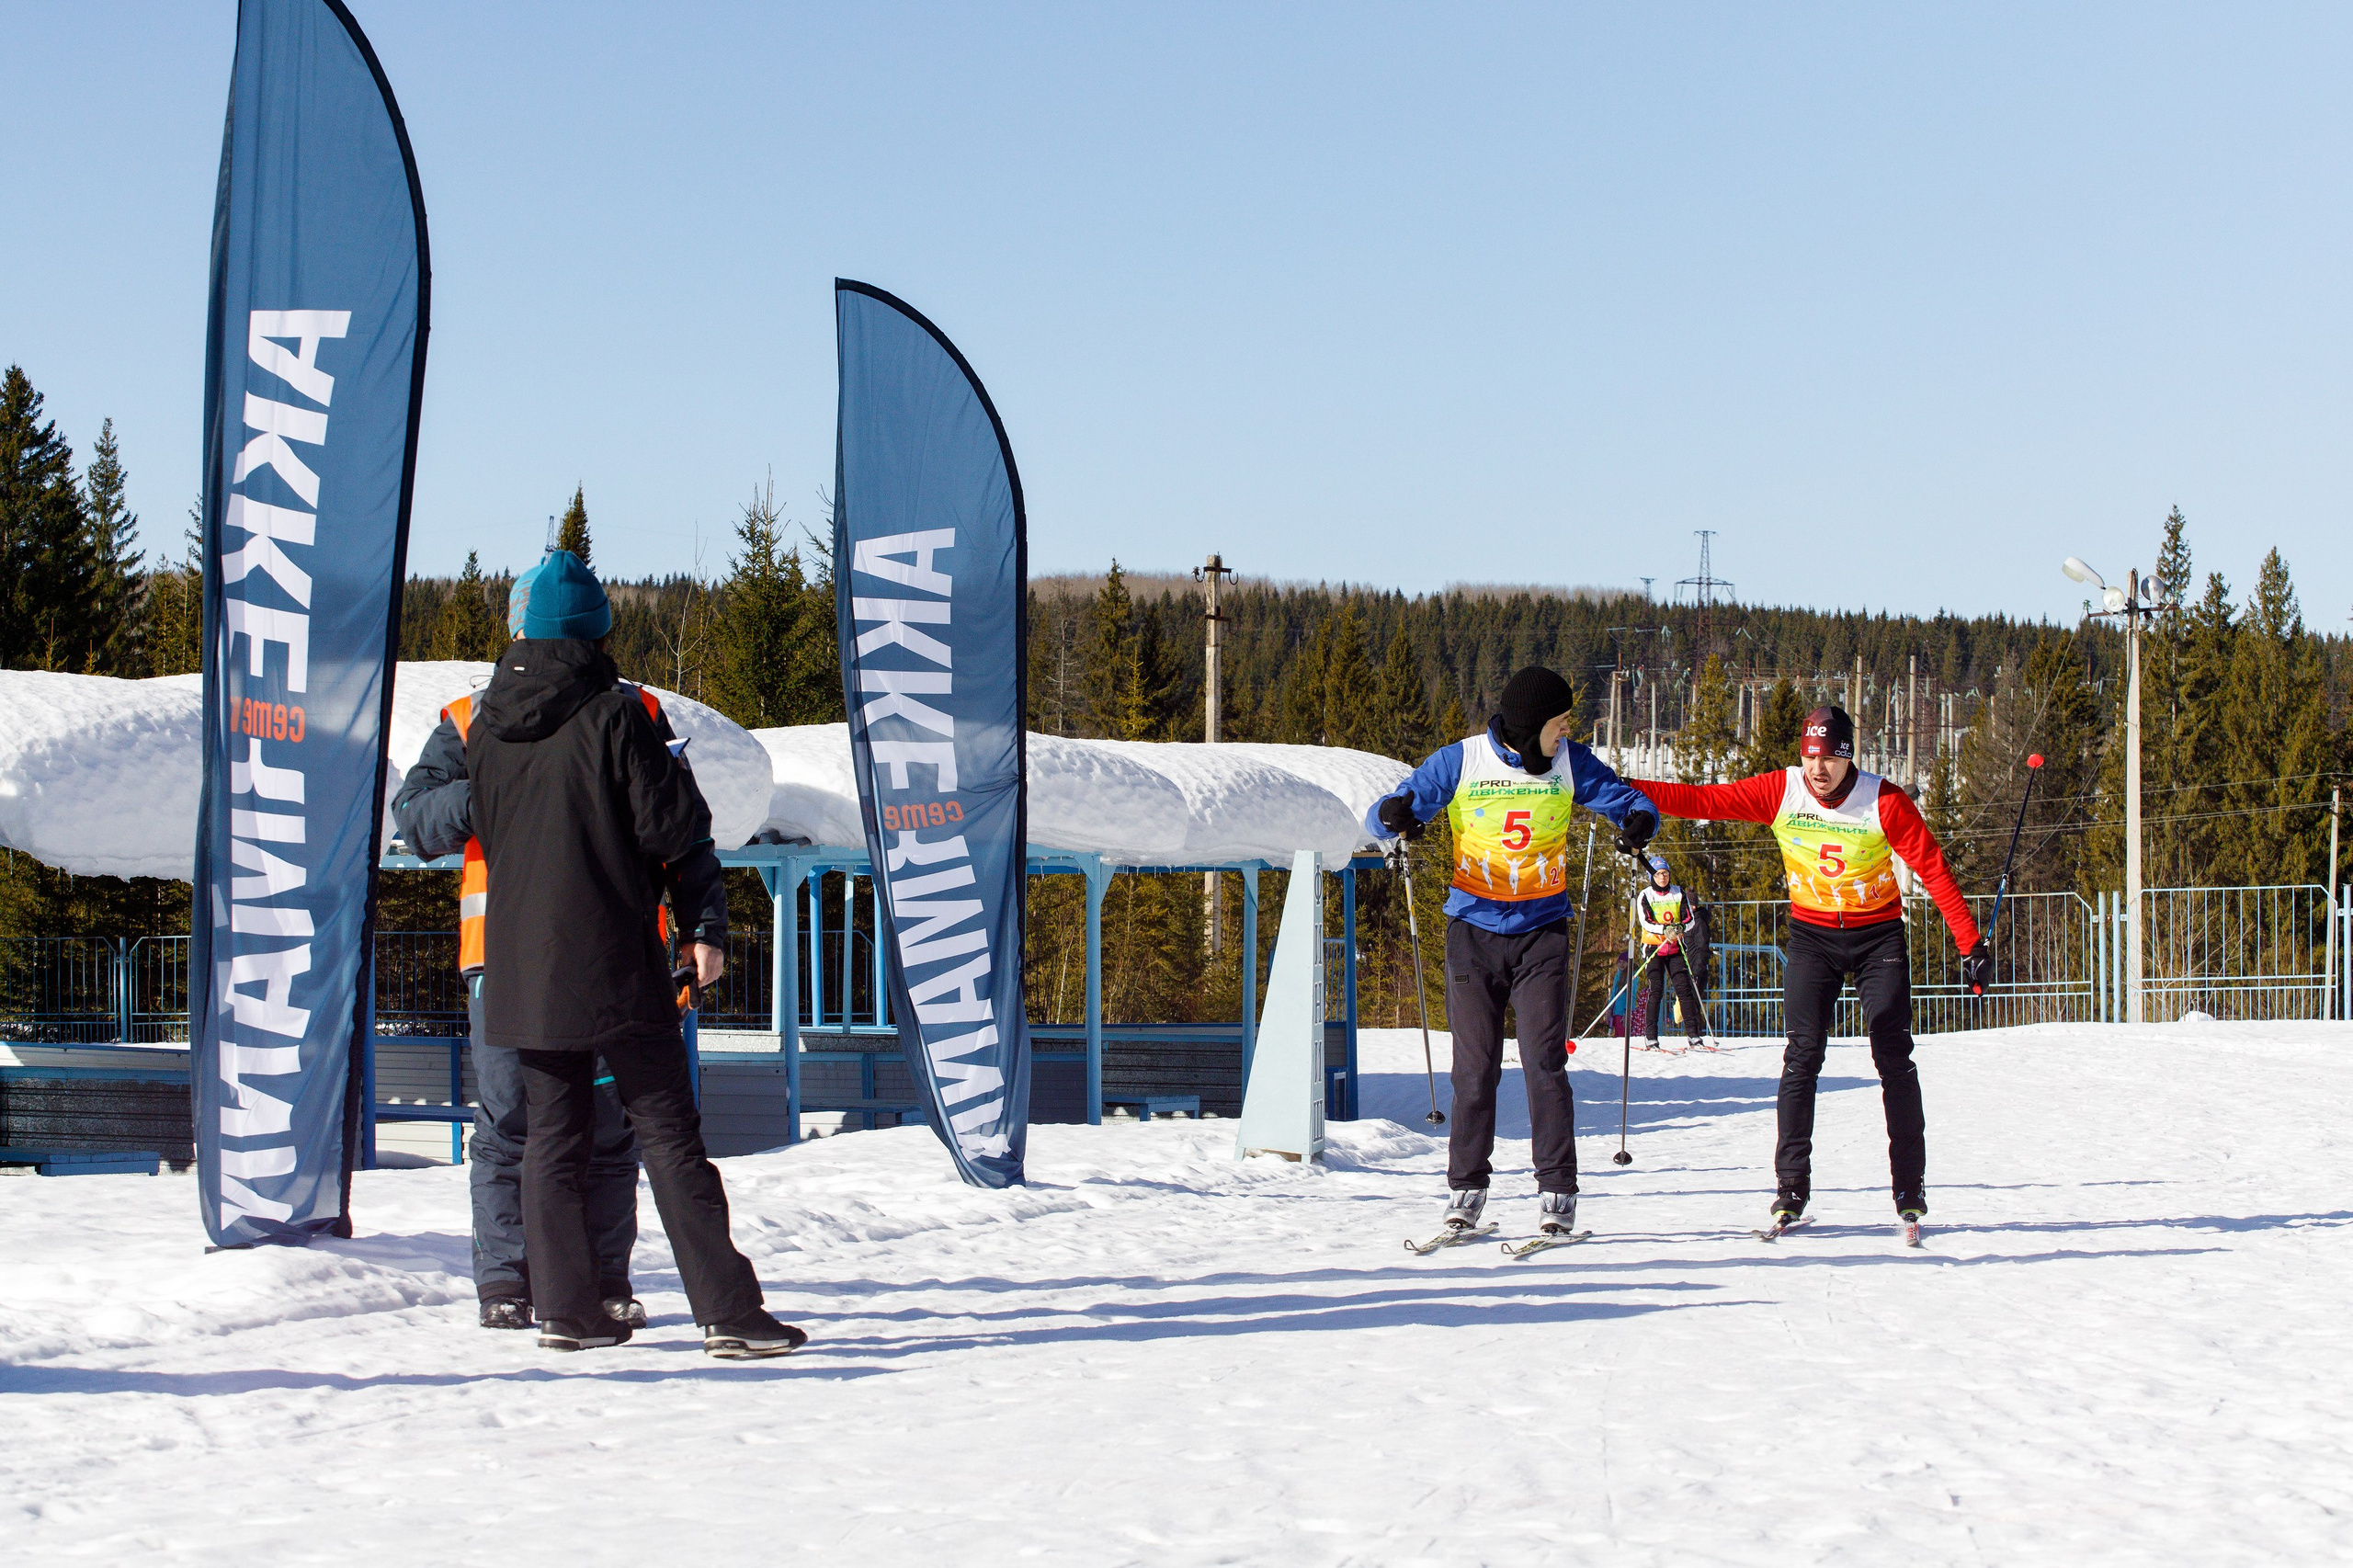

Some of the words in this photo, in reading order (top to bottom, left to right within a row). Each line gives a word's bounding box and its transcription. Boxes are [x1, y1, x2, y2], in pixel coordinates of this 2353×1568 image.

[1805, 722, 1827, 737] ice
[1501, 810, 1532, 852] 5
[1550, 867, 1560, 886] 2
[1818, 843, 1847, 878] 5
[1313, 864, 1324, 1142] ФИНИШ
